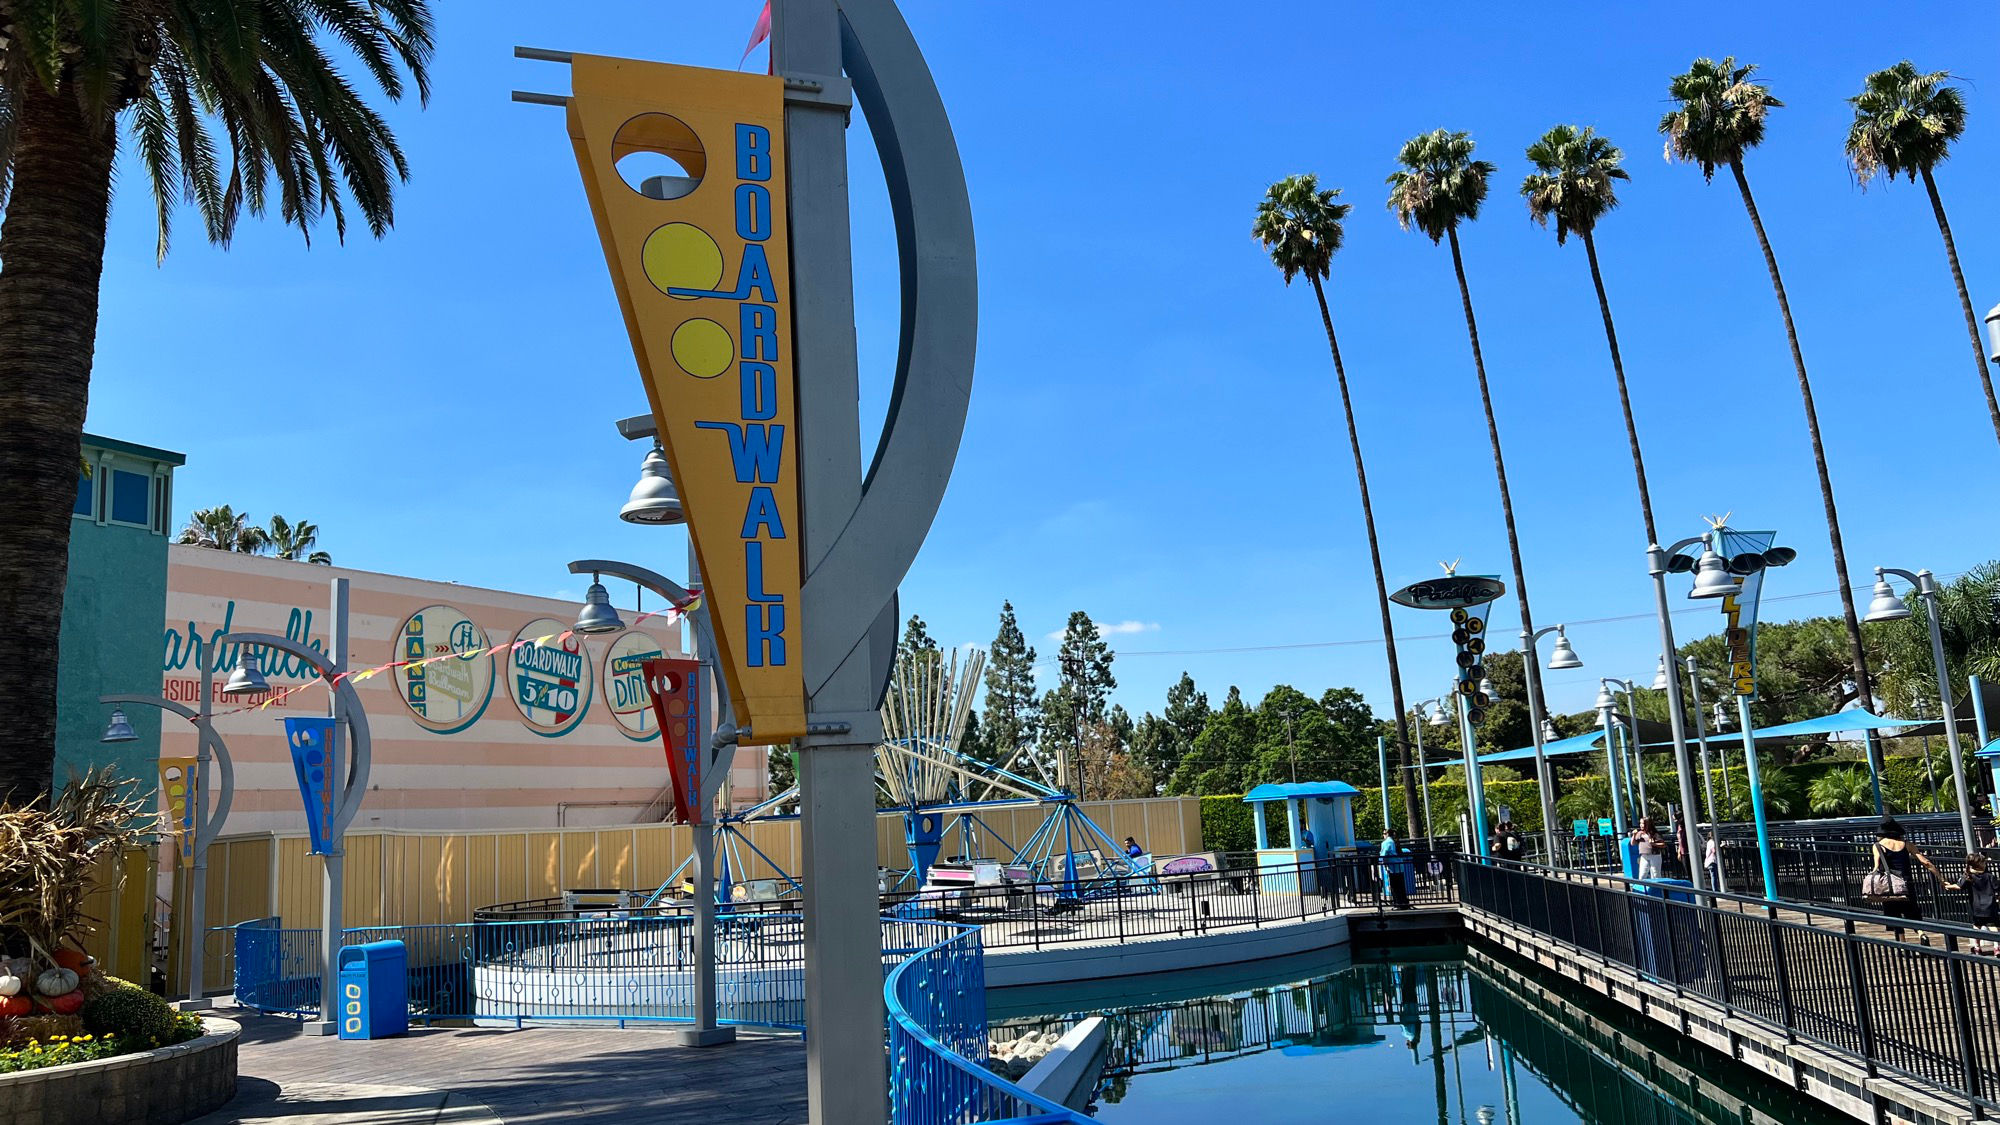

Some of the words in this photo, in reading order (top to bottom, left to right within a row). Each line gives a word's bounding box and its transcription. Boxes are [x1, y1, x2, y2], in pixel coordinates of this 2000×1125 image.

[1722, 577, 1754, 695] LIDERS
[518, 643, 581, 679] BOARDWALK
[547, 688, 575, 711] 10
[614, 673, 649, 708] DIN
